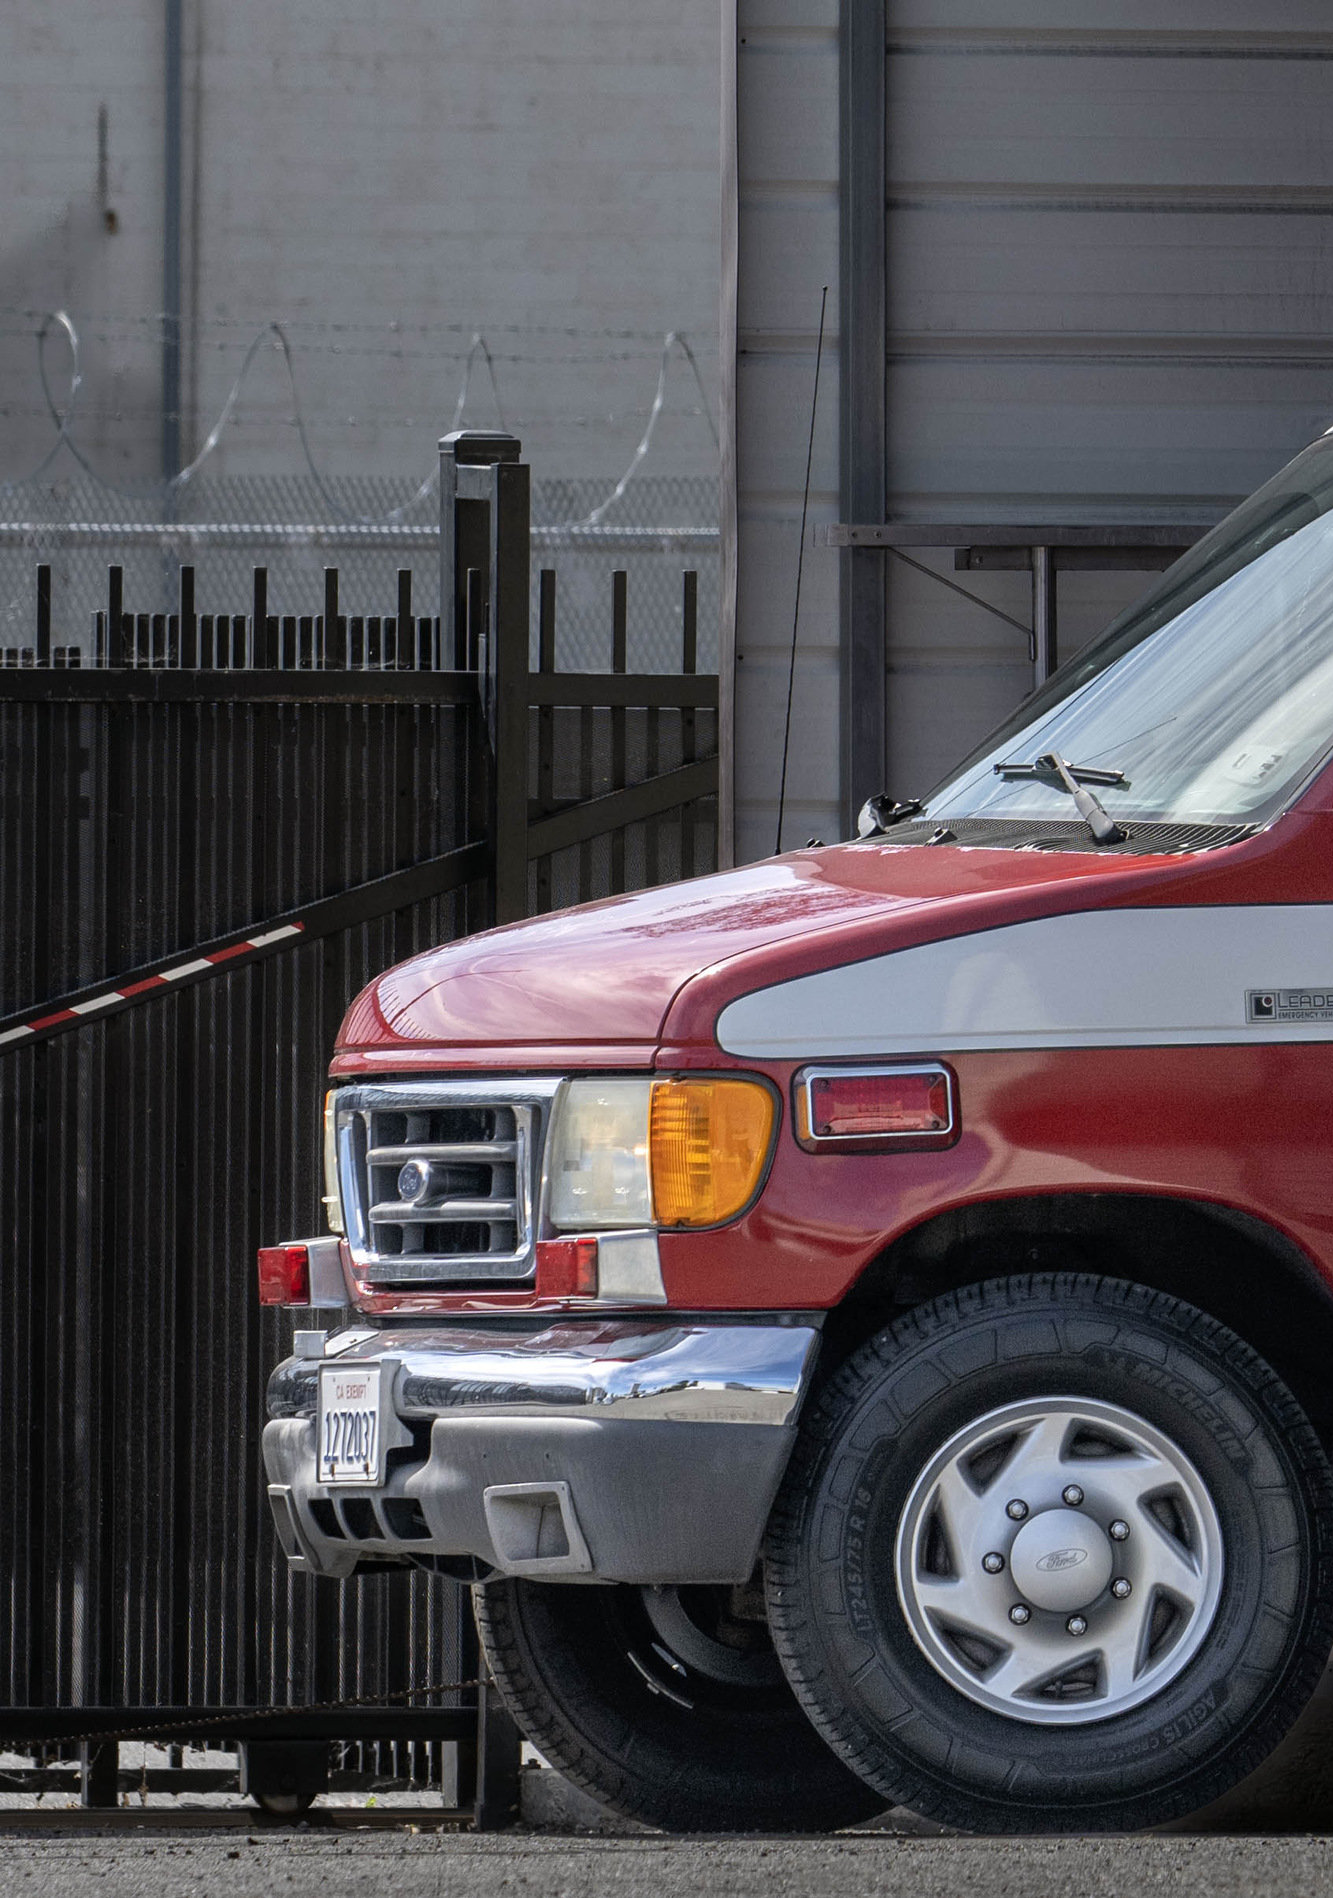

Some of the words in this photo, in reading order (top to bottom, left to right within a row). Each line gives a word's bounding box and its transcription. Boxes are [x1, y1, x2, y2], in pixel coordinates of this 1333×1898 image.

[336, 1385, 344, 1399] CA
[346, 1384, 367, 1399] EXEMPT
[1130, 1362, 1247, 1459] MICHELIN
[323, 1411, 376, 1464] 1272037
[850, 1514, 865, 1530] R
[1046, 1551, 1078, 1569] Ford
